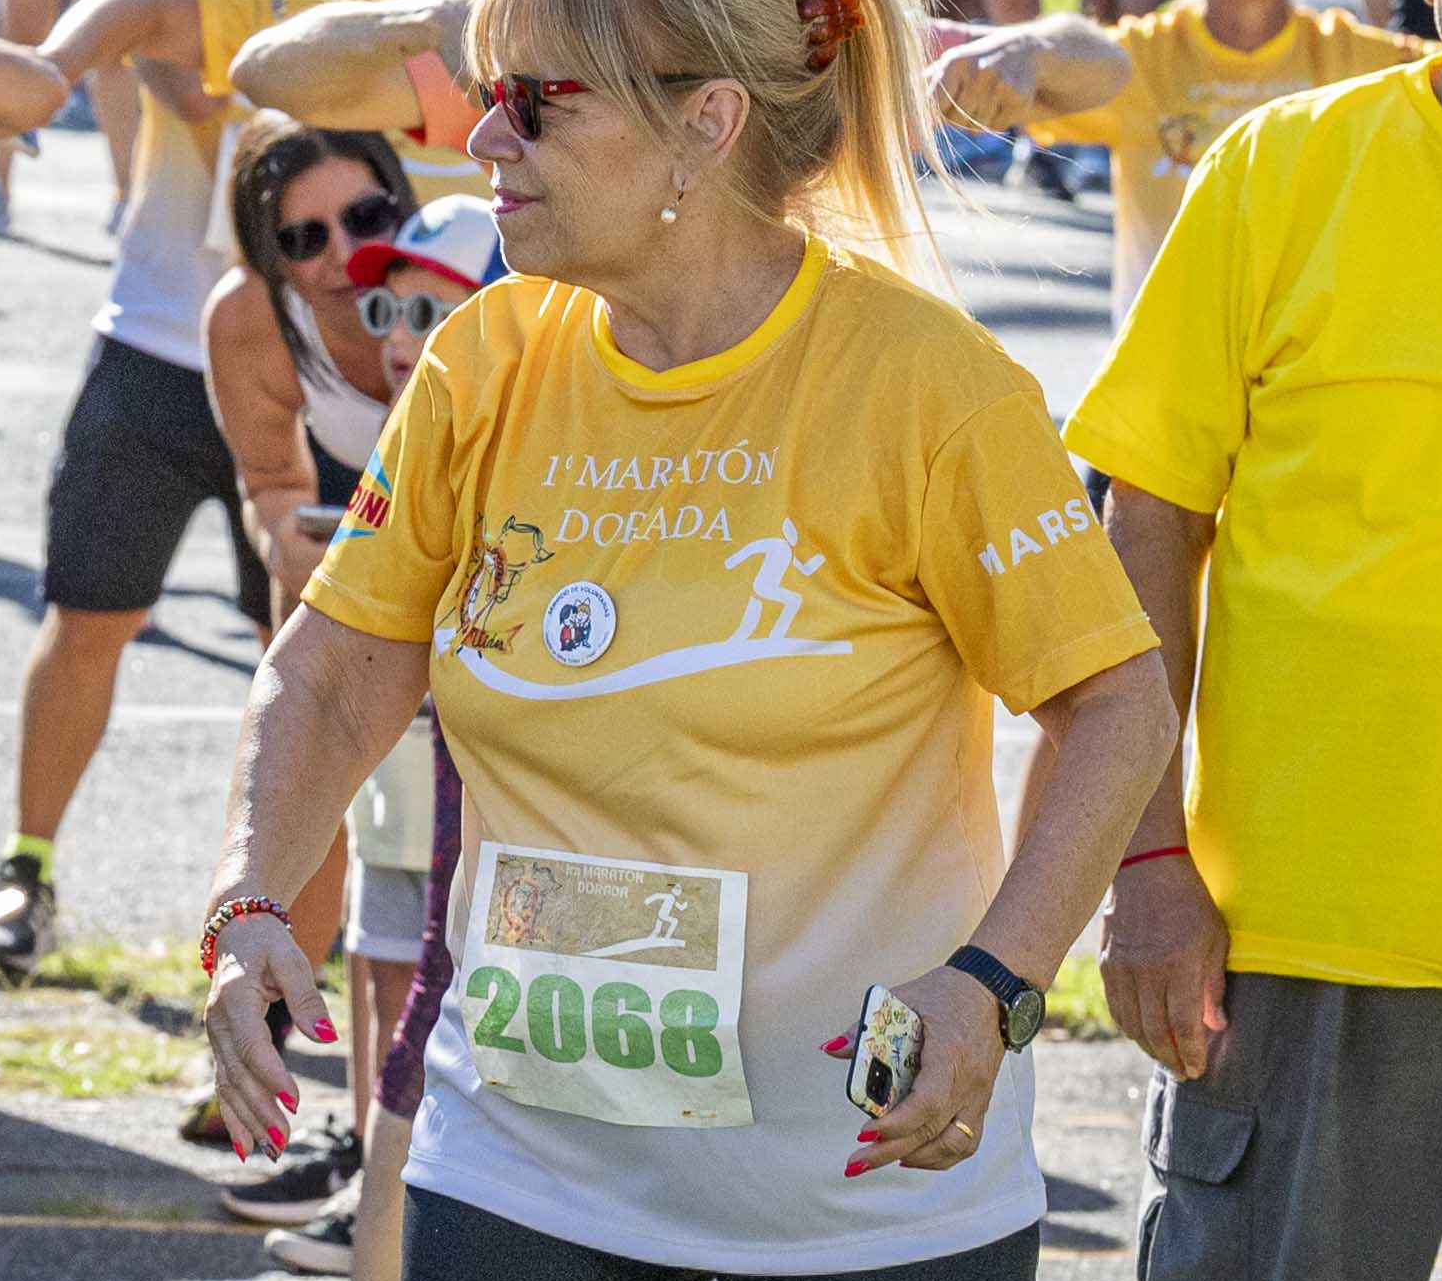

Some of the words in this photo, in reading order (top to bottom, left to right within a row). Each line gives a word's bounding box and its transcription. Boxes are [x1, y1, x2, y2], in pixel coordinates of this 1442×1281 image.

[575, 439, 779, 491] MARATÓN
[577, 881, 629, 900] DORADA
[466, 965, 723, 1078] 2068
